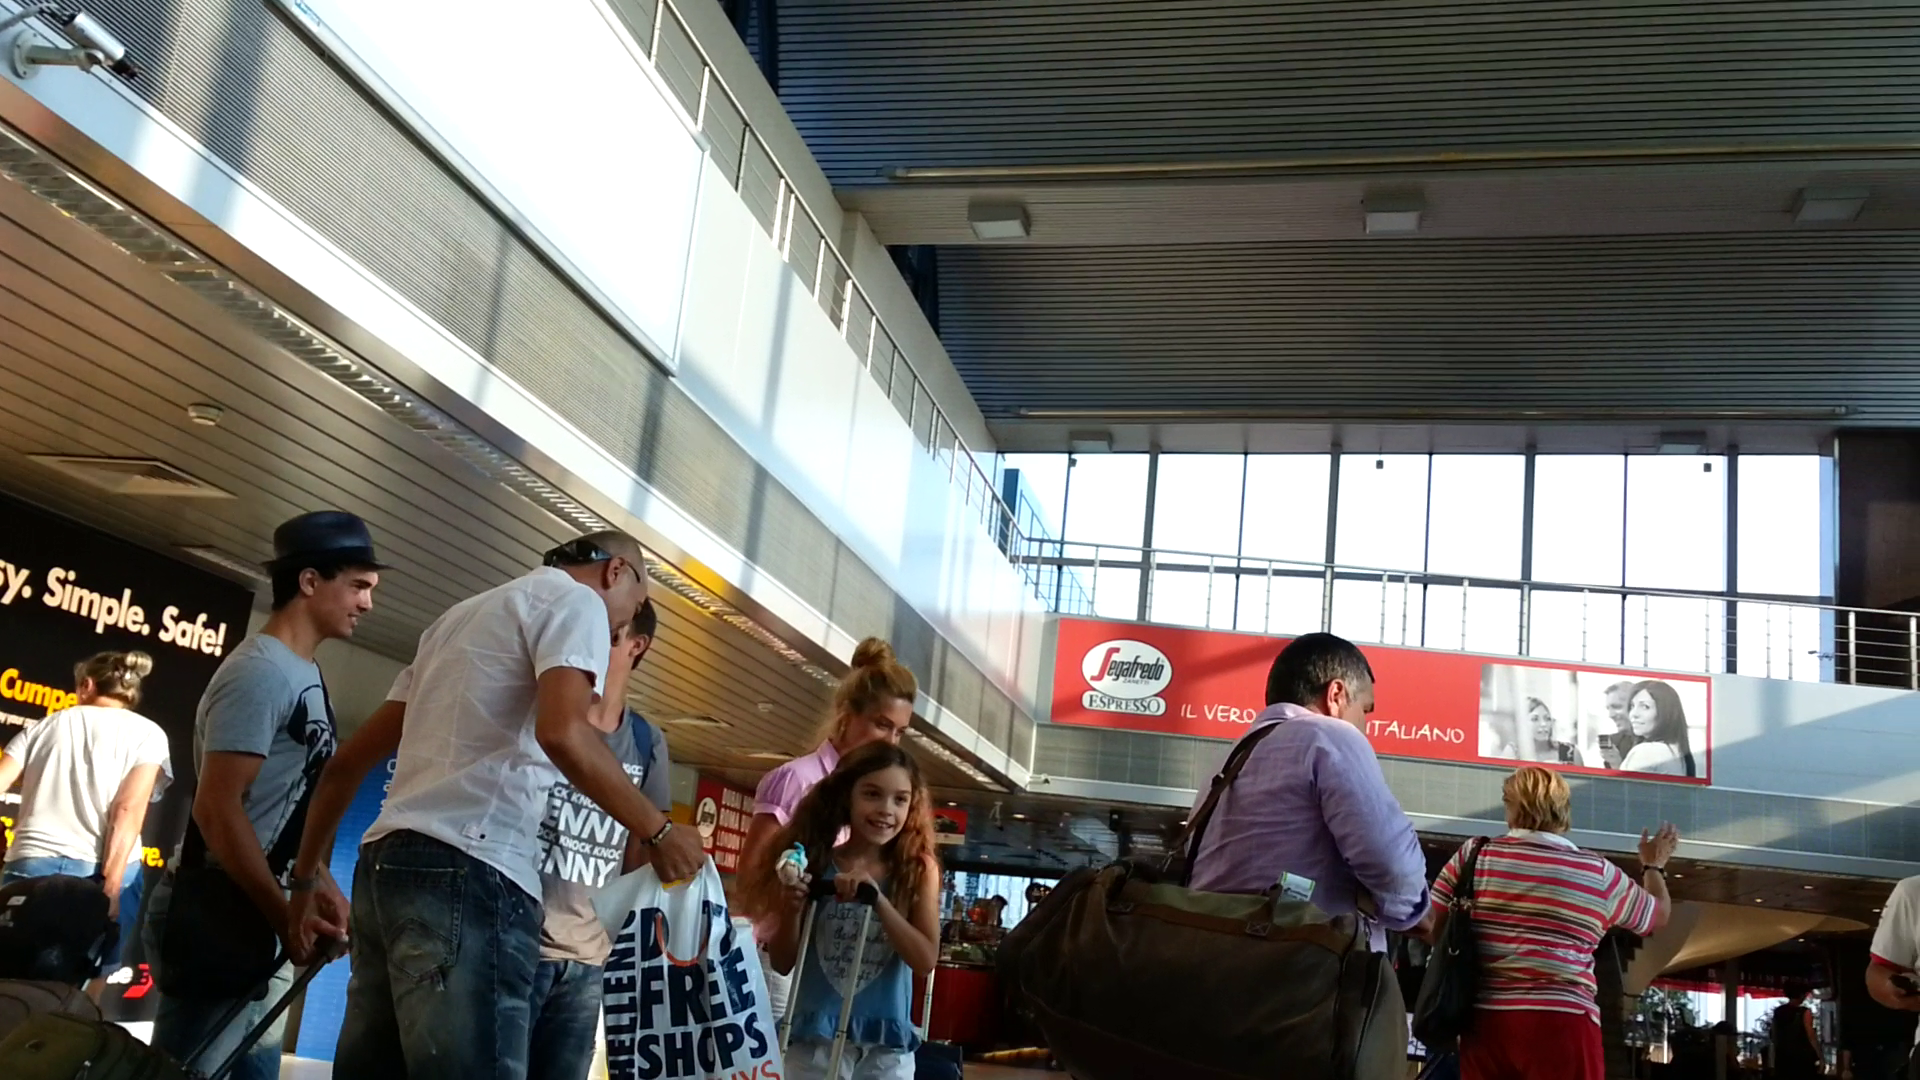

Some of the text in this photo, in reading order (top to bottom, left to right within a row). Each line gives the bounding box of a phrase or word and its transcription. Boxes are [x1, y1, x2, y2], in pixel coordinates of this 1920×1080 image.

[42, 567, 150, 634] Simple.
[158, 605, 227, 657] Safe!
[1090, 647, 1165, 682] Segafredo
[1088, 694, 1161, 714] ESPRESSO
[1180, 703, 1465, 744] IL VERO ITALIANO
[559, 834, 594, 855] KNOCK
[639, 946, 756, 1031] FREE
[637, 1011, 769, 1080] SHOPS
